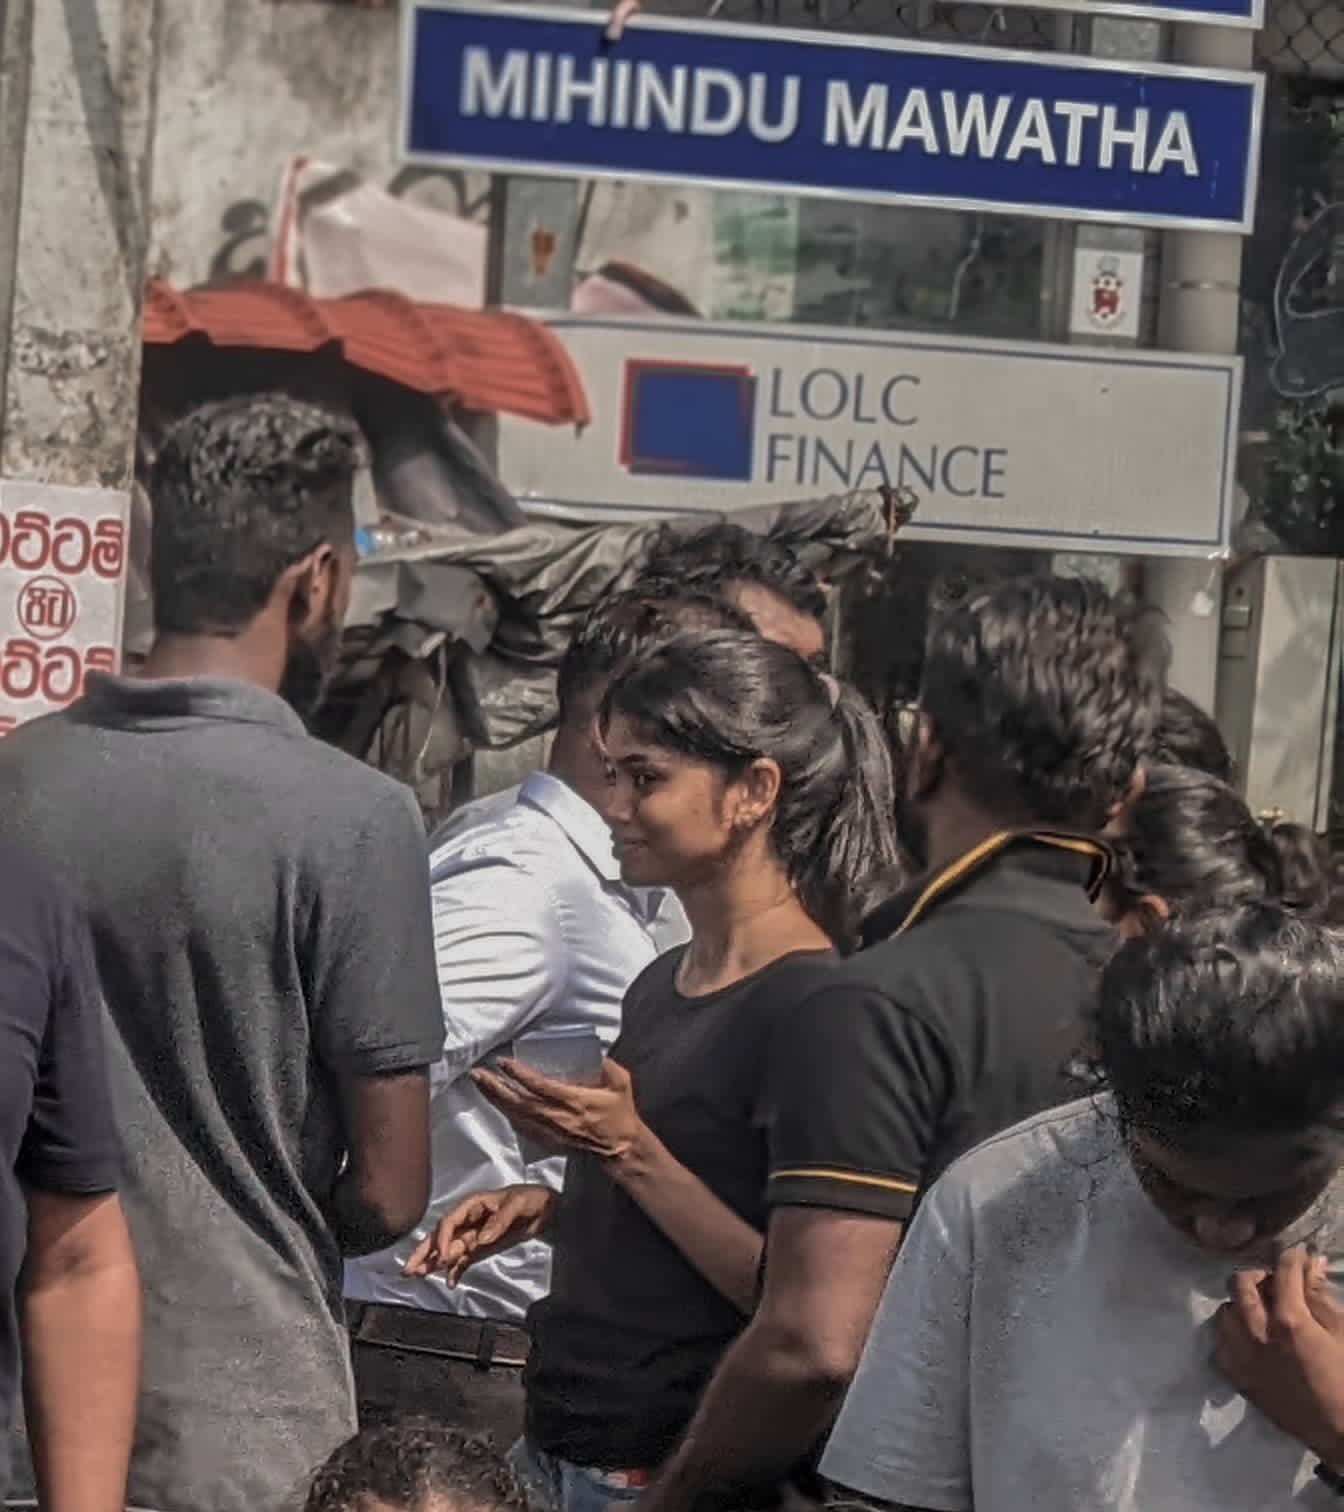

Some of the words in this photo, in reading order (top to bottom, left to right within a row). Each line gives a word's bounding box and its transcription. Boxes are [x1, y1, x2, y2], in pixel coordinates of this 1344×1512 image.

[459, 45, 801, 143] MIHINDU
[822, 79, 1201, 176] MAWATHA
[769, 367, 921, 428] LOLC
[764, 435, 1009, 501] FINANCE
